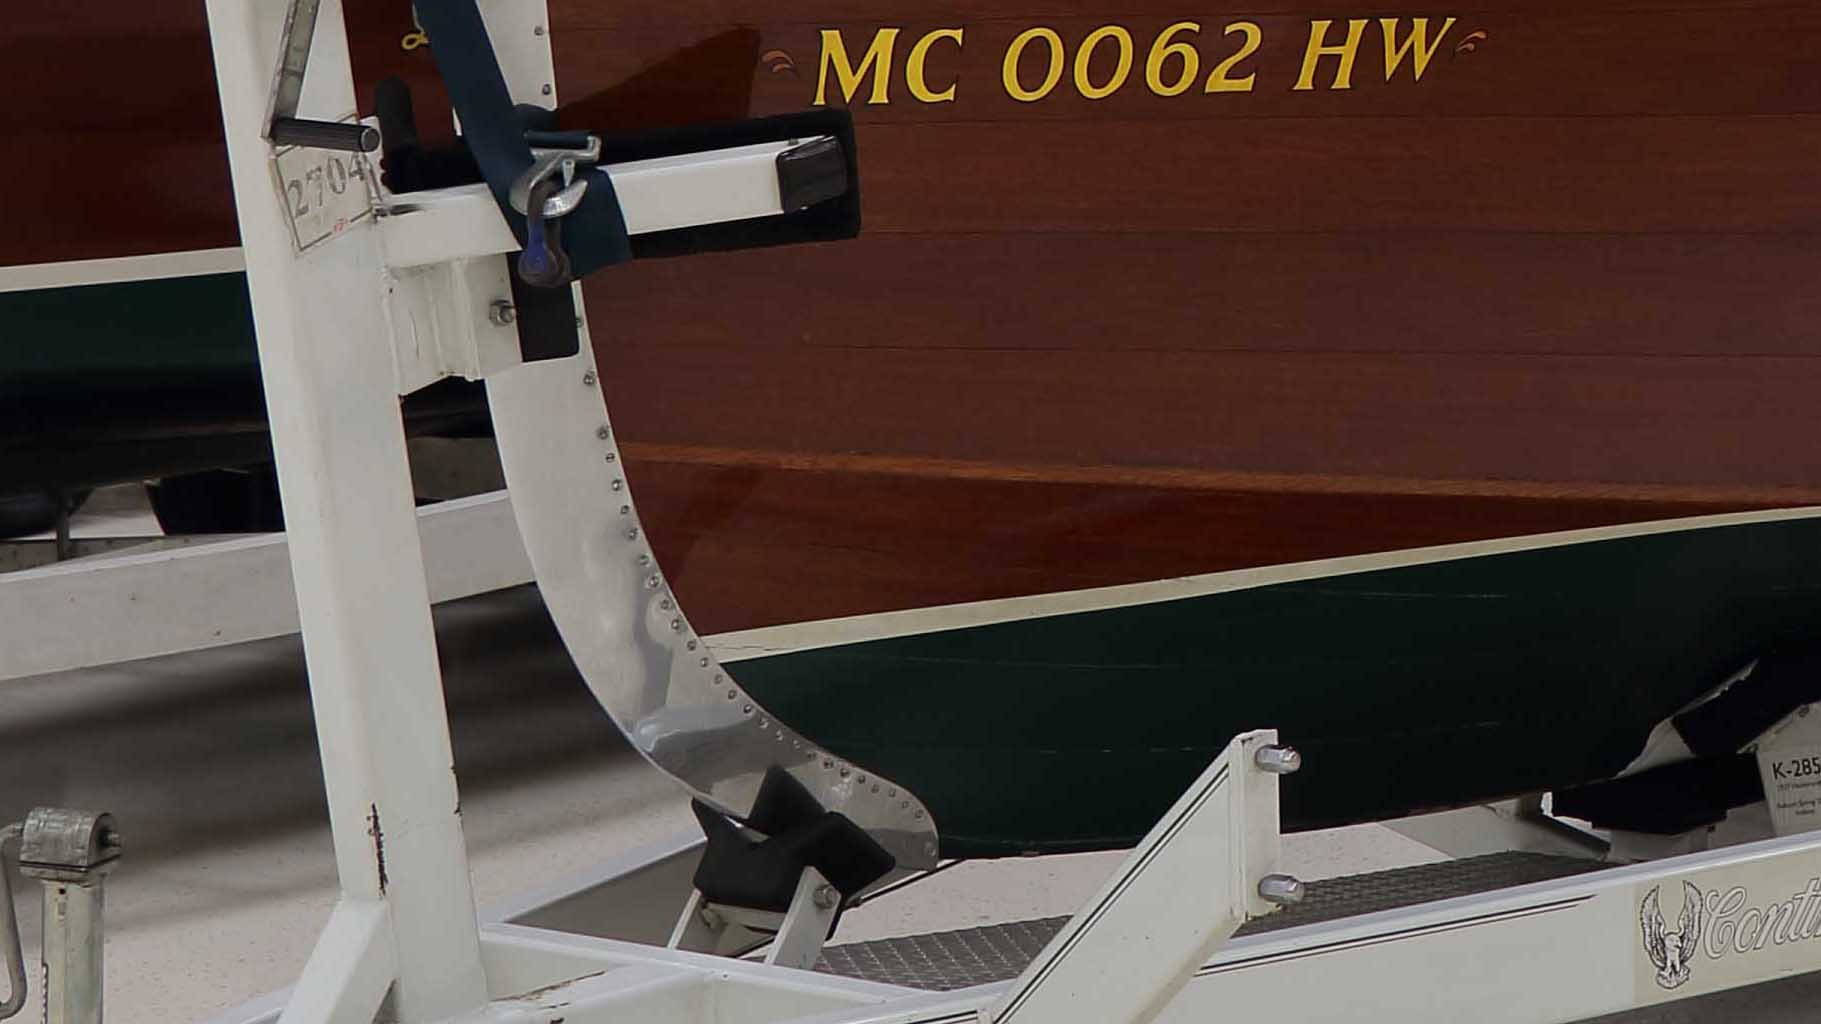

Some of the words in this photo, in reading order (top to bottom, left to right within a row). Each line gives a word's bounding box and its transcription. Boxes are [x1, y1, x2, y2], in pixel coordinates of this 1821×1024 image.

[811, 27, 964, 107] MC
[1000, 20, 1263, 104] 0062
[1292, 17, 1458, 91] HW
[1772, 756, 1821, 779] K-285
